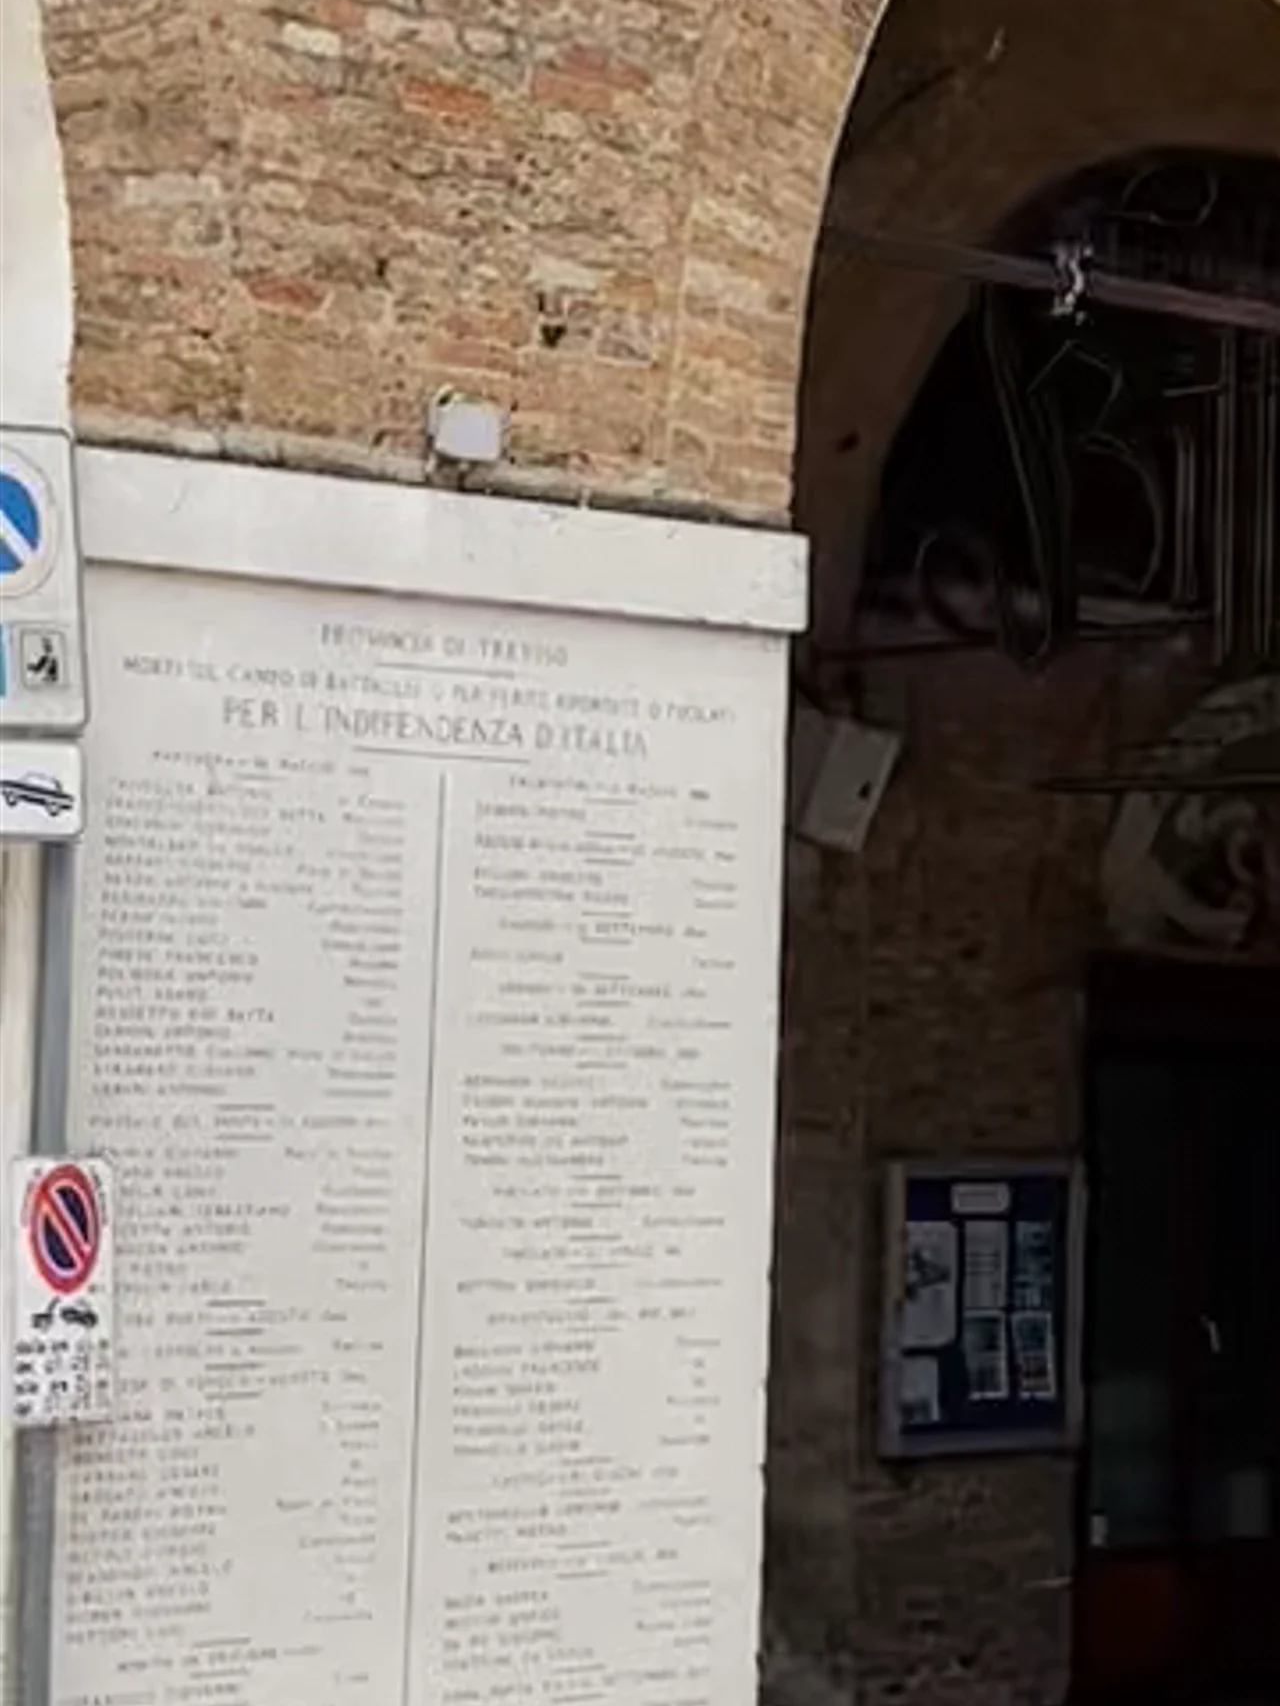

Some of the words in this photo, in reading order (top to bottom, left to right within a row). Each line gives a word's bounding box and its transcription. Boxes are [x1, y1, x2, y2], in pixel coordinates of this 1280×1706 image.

[319, 621, 434, 653] PROVINCIA
[442, 635, 466, 656] DI
[478, 637, 570, 667] TREVISO
[225, 663, 295, 688] CAMPO
[221, 695, 280, 729] PER
